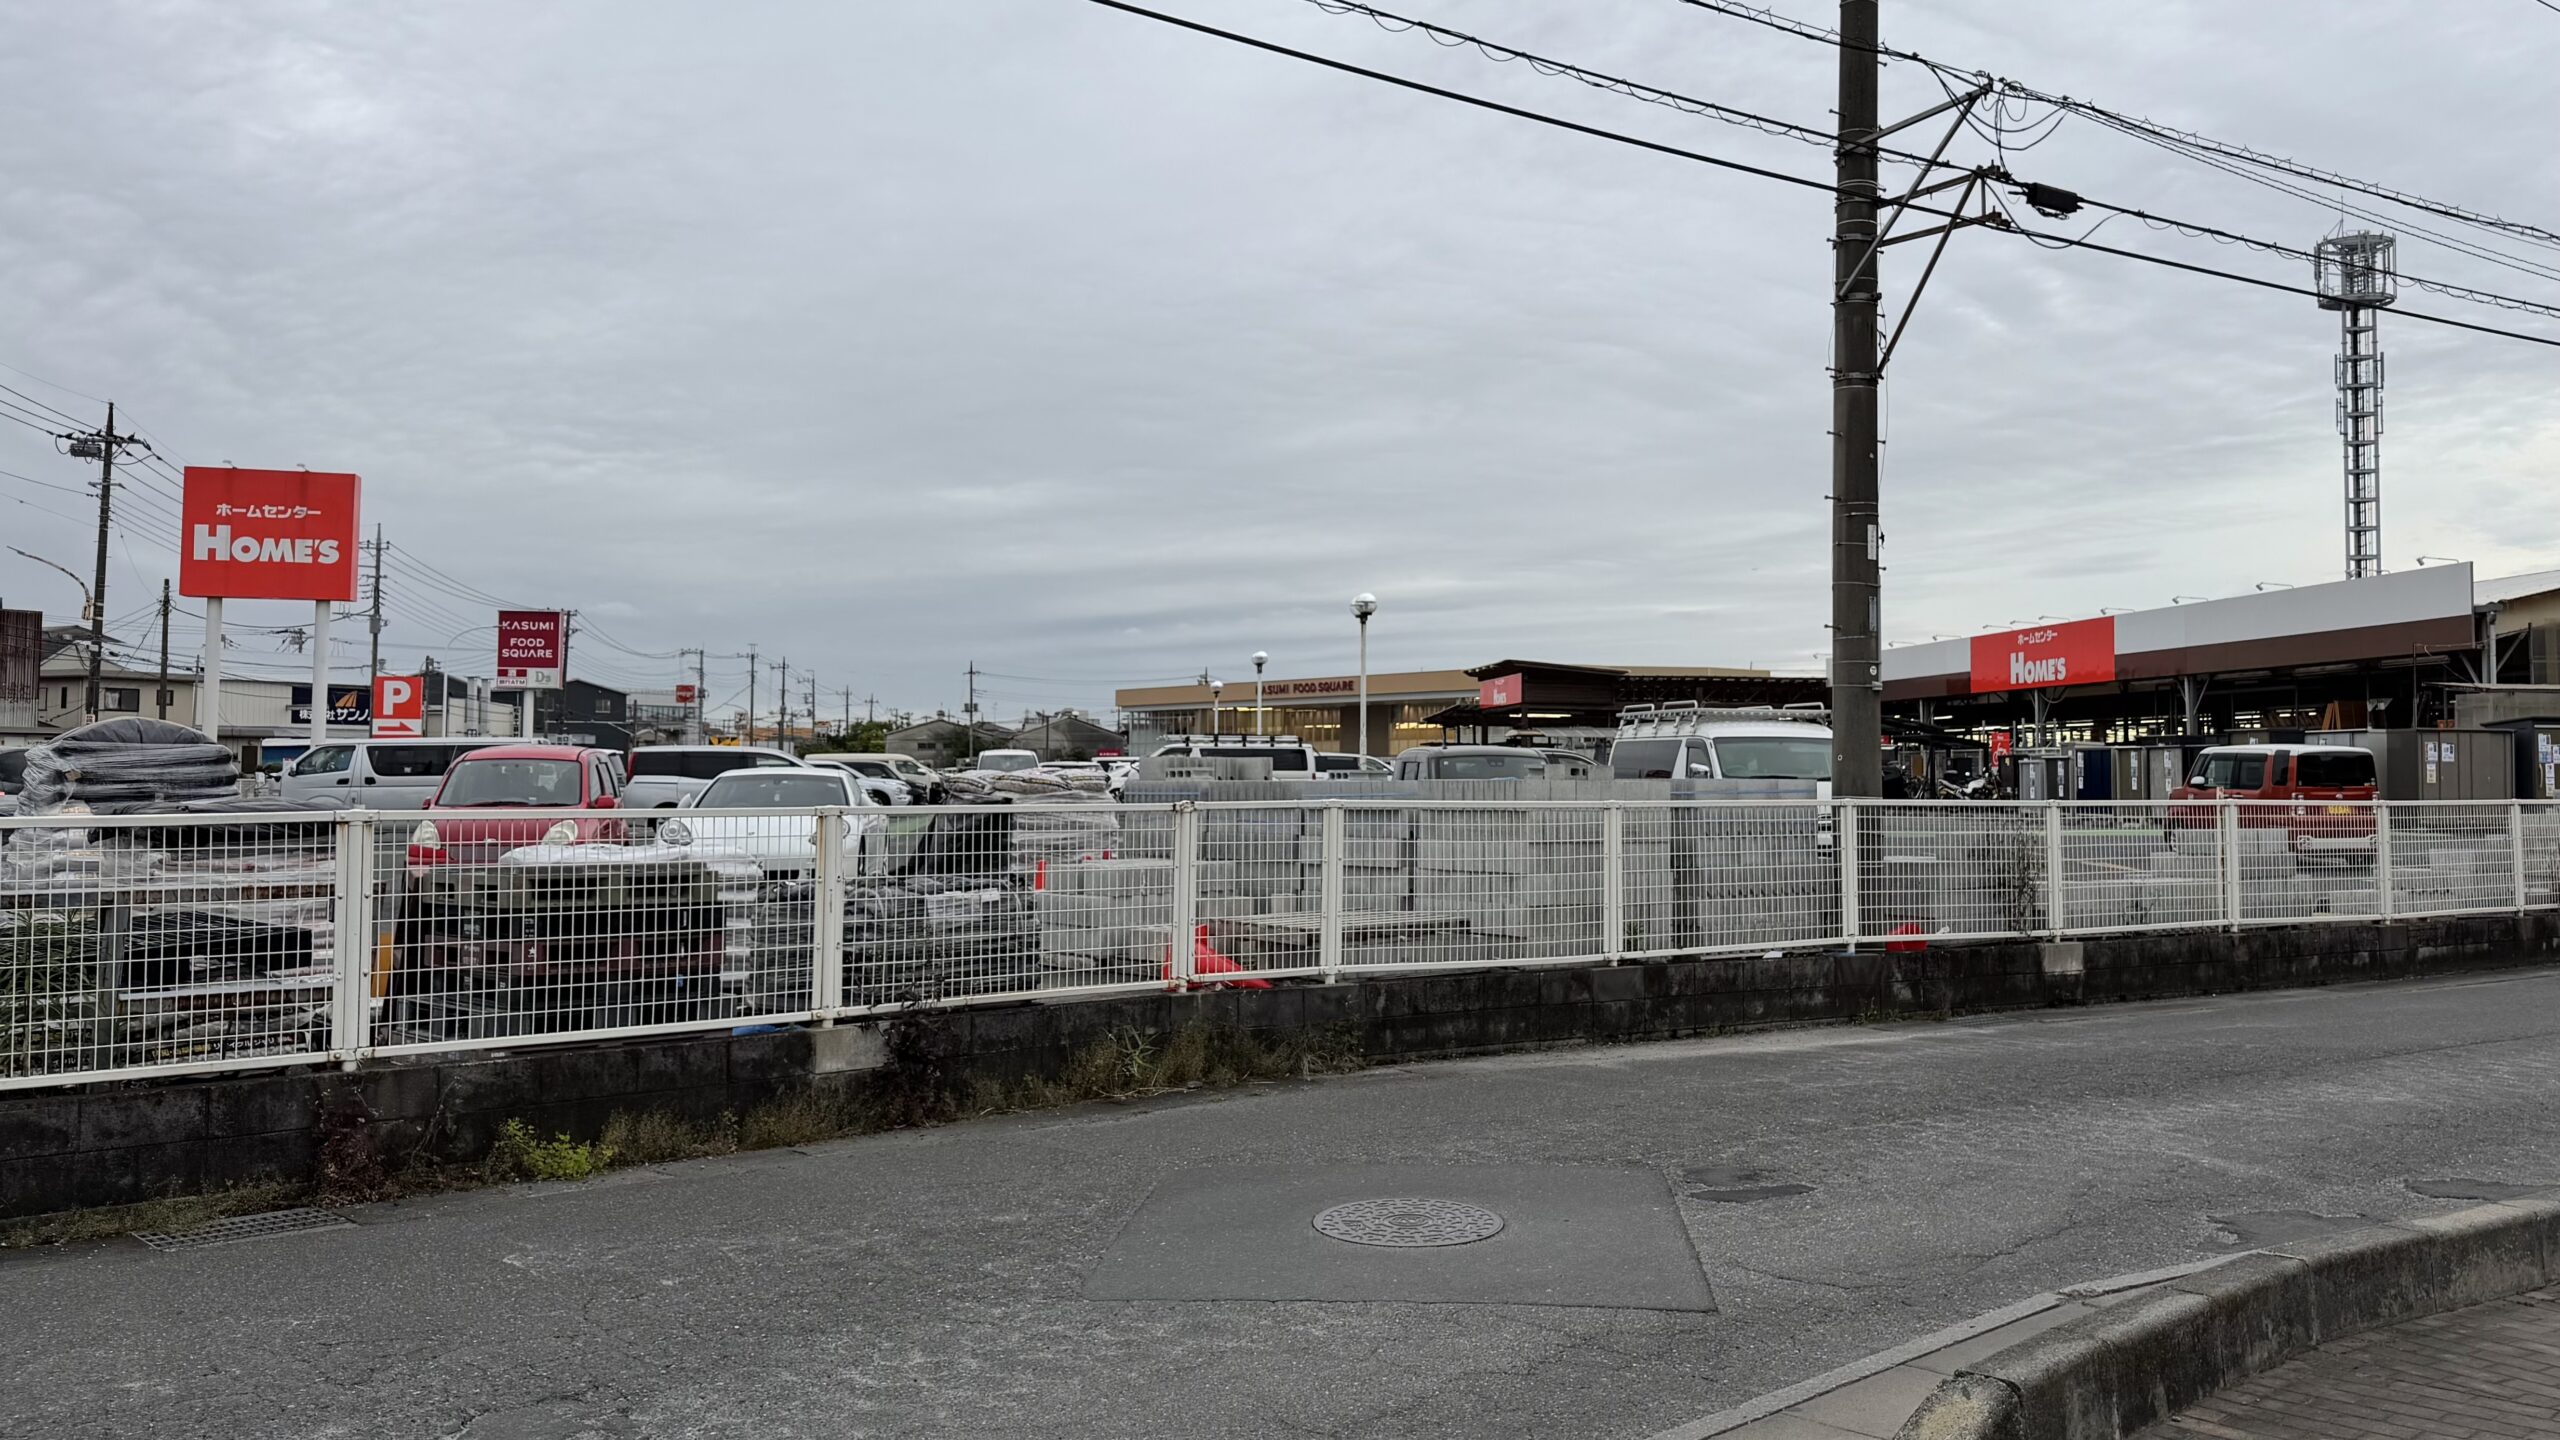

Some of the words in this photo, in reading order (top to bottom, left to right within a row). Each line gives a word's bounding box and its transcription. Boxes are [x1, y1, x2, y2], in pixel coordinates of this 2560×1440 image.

[216, 503, 321, 519] ホームセンター
[193, 523, 340, 564] HOME'S
[502, 621, 554, 631] KASUMI
[510, 638, 545, 647] FOOD
[2017, 630, 2058, 645] ホームセンター
[502, 648, 553, 658] SQUARE
[2010, 652, 2067, 684] HOME'S
[1256, 684, 1290, 696] ASUMI
[1293, 683, 1317, 694] FOOD
[1318, 680, 1354, 693] SQUARE
[383, 680, 411, 716] P
